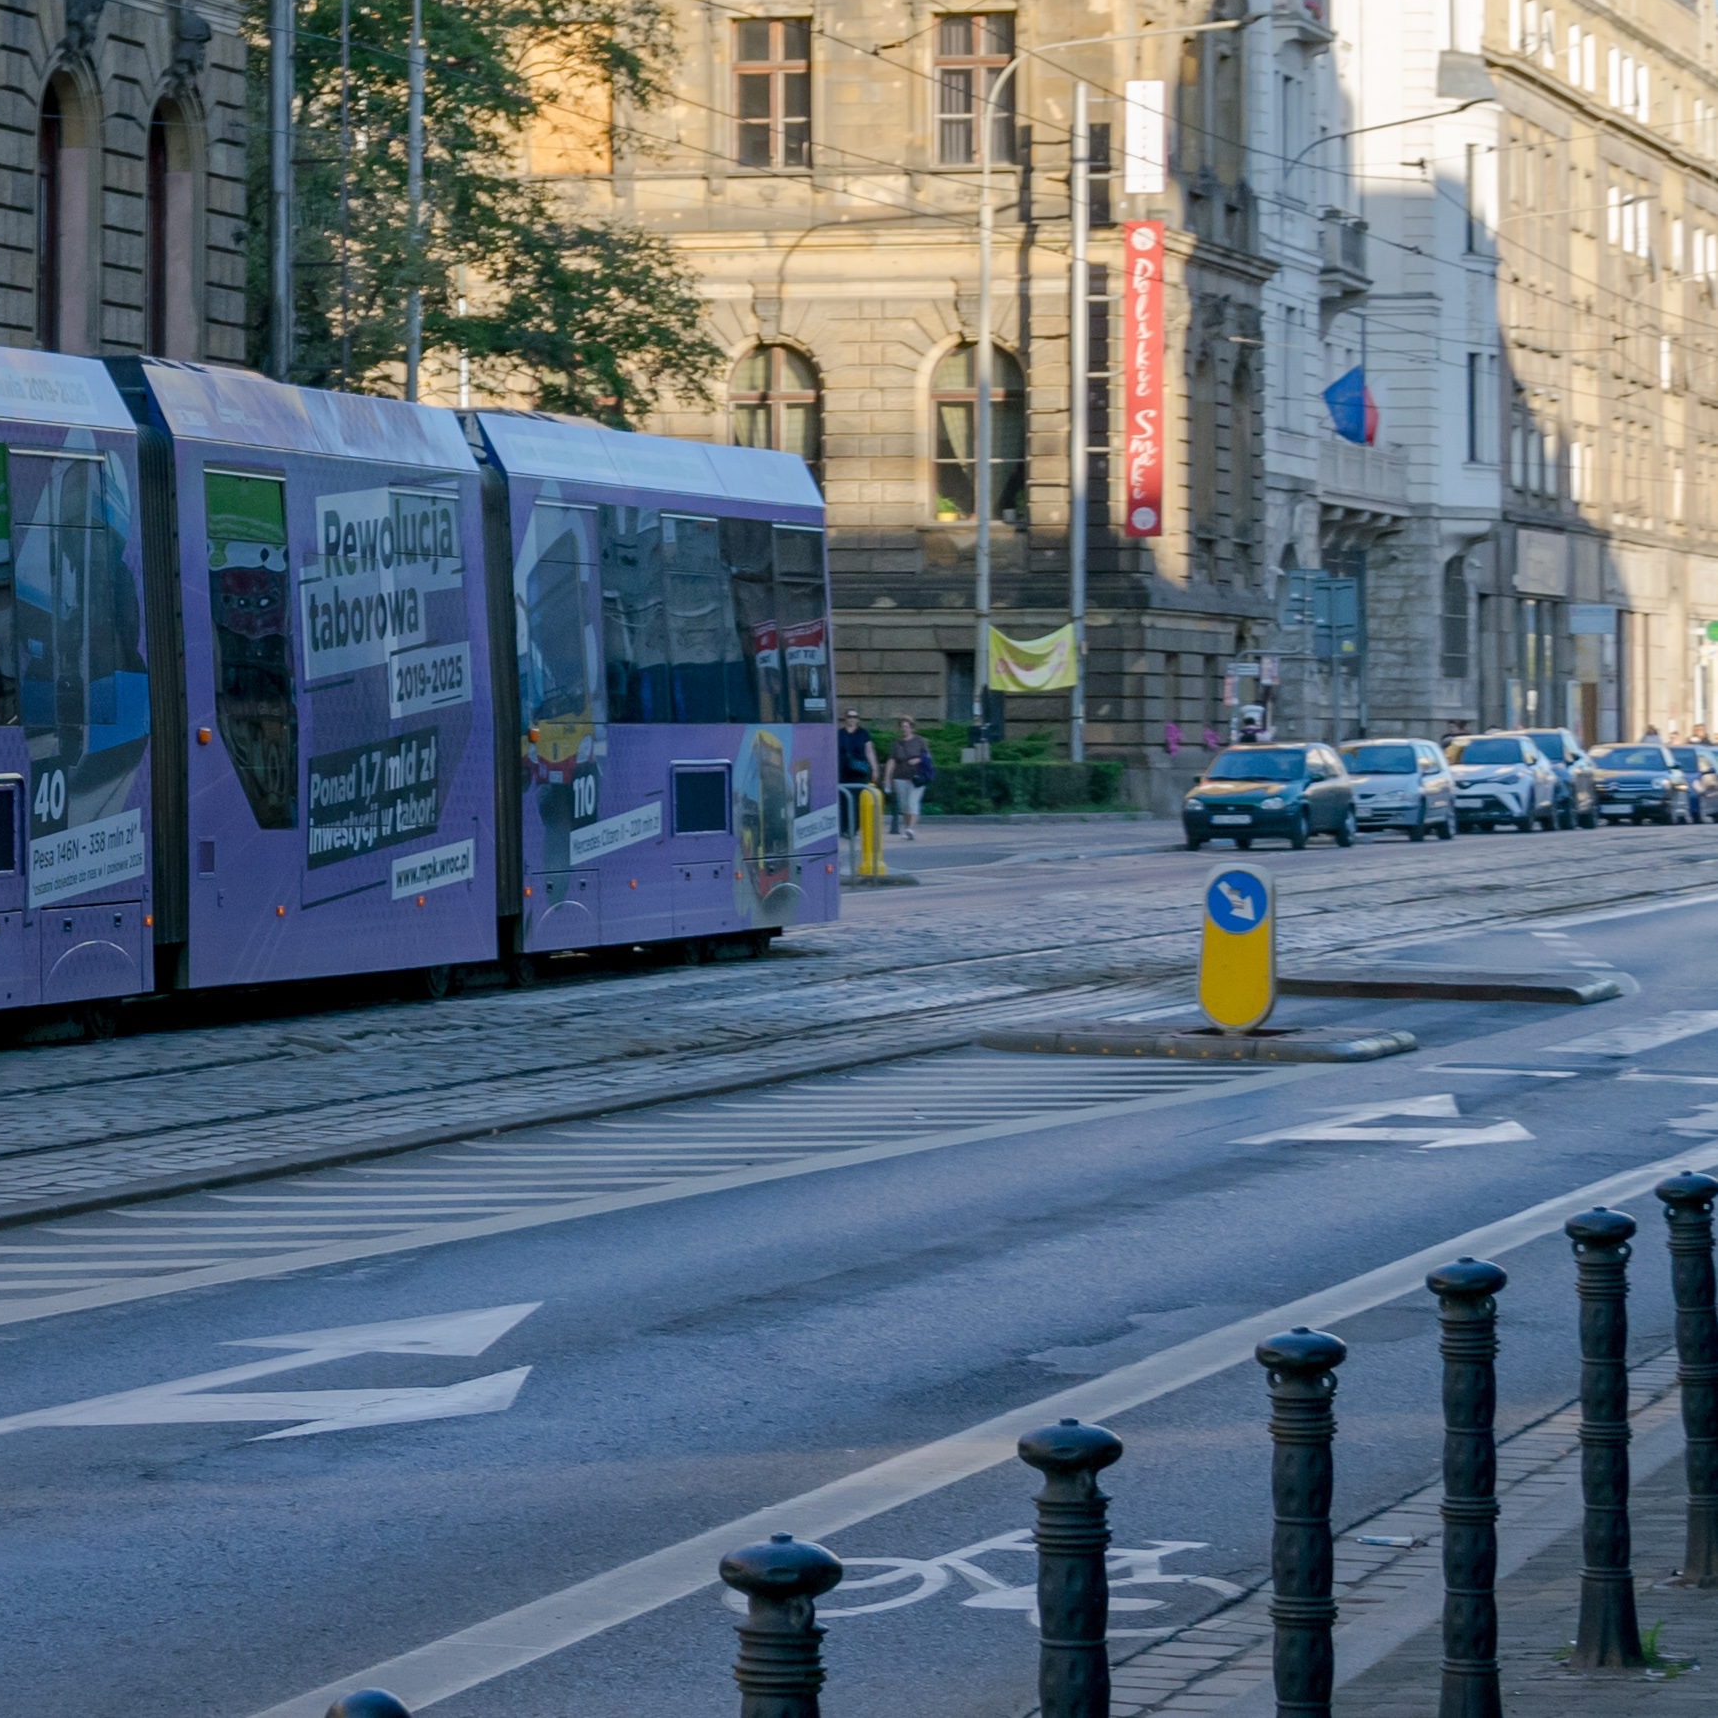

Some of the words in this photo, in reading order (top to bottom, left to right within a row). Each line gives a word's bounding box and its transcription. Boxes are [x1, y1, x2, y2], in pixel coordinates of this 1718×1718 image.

[324, 495, 452, 579] Rewolucja
[308, 584, 420, 653] taborowa
[396, 654, 463, 703] 2019-2025
[34, 769, 65, 822] 40
[310, 763, 357, 809] Ponad
[359, 750, 382, 805] 1,7
[384, 740, 417, 792] mld
[420, 735, 437, 782] zł
[573, 774, 595, 819] 110
[795, 769, 809, 807] 13
[308, 802, 379, 852] inwestycji
[381, 807, 394, 836] w
[396, 788, 437, 833] tabor!
[33, 849, 55, 871] Pesa
[57, 838, 80, 864] 146N
[89, 830, 106, 856] 358
[107, 825, 124, 850] mln
[395, 846, 470, 889] www.mpk.wroc.pl
